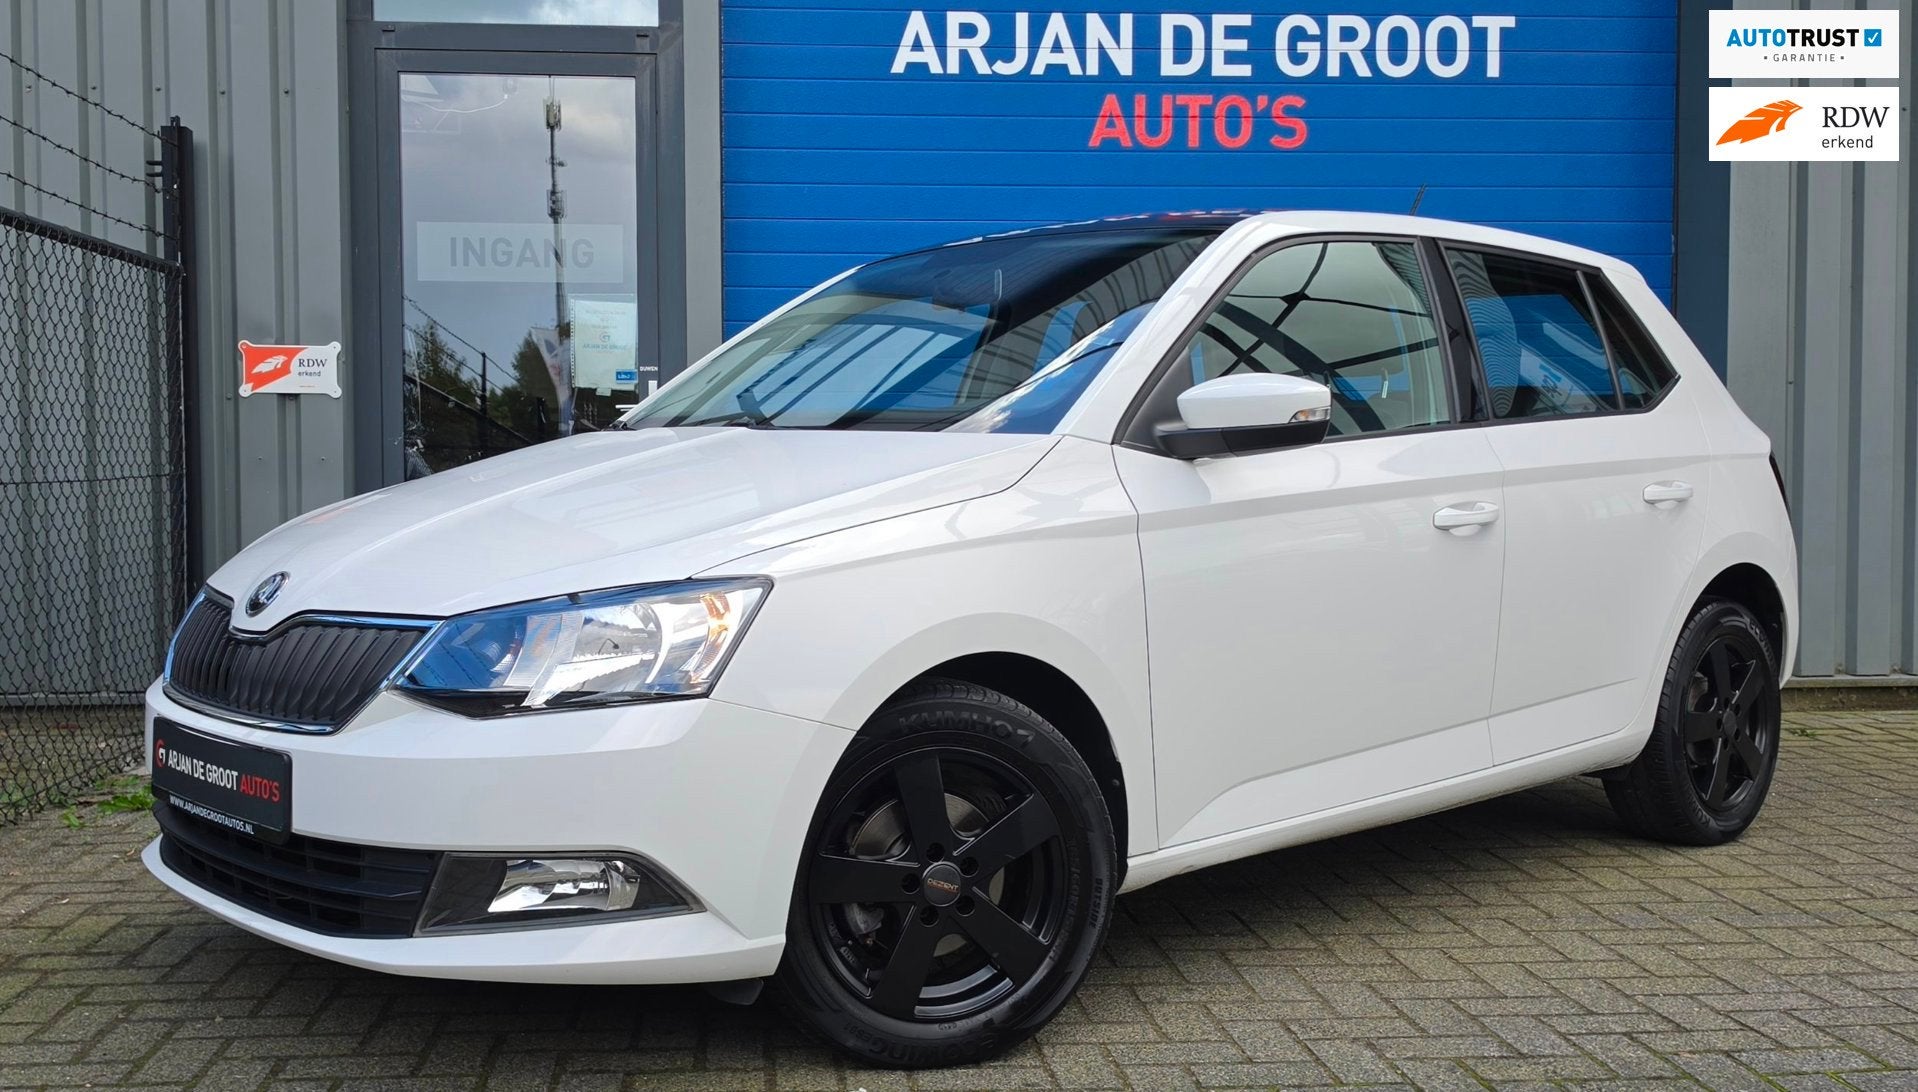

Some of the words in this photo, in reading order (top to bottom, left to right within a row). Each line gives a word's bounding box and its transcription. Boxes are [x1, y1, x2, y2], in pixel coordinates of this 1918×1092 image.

[890, 10, 1133, 76] ARJAN
[1160, 13, 1252, 77] DE
[1275, 14, 1516, 78] GROOT
[1088, 93, 1308, 149] AUTO'S
[450, 237, 594, 268] INGANG
[298, 358, 328, 368] RDW
[168, 749, 192, 775] ARJAN
[193, 758, 205, 781] DE
[206, 763, 239, 790] GROOT
[240, 774, 280, 803] AUTO'S
[169, 794, 255, 835] WWW.ARJANDEGROOTAUTOS.NL
[927, 878, 959, 891] DEZENT
[1088, 877, 1103, 929] OUTSIDE
